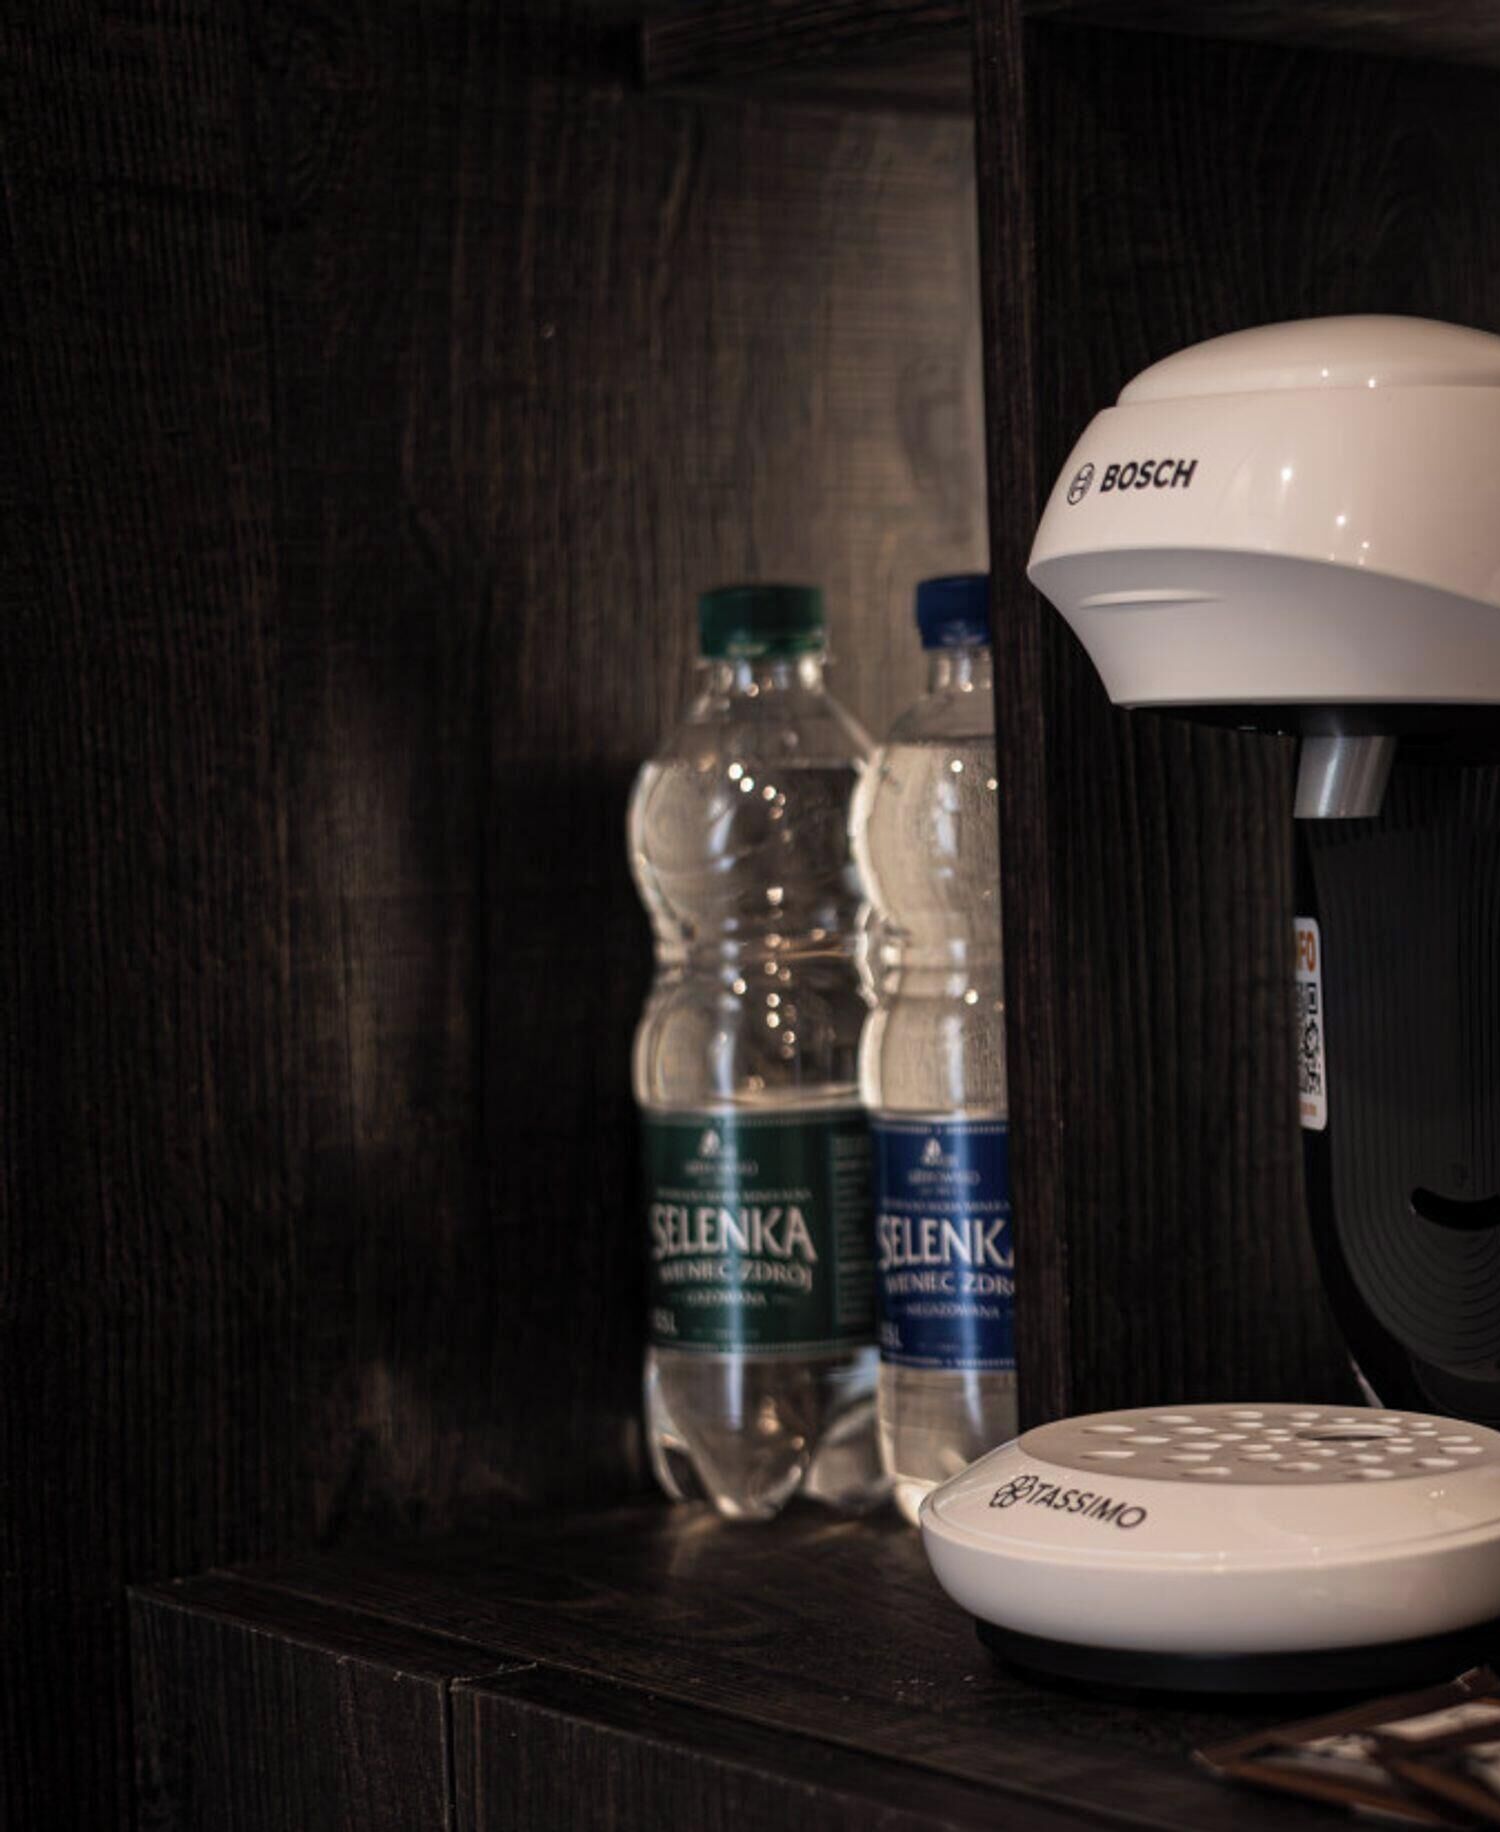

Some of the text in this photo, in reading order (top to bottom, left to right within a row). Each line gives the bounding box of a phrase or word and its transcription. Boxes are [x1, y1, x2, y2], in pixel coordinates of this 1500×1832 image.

[1100, 459, 1198, 492] BOSCH
[651, 1203, 818, 1263] SELENKA
[962, 1271, 1015, 1296] ZDR
[1026, 1482, 1148, 1529] TASSIMO
